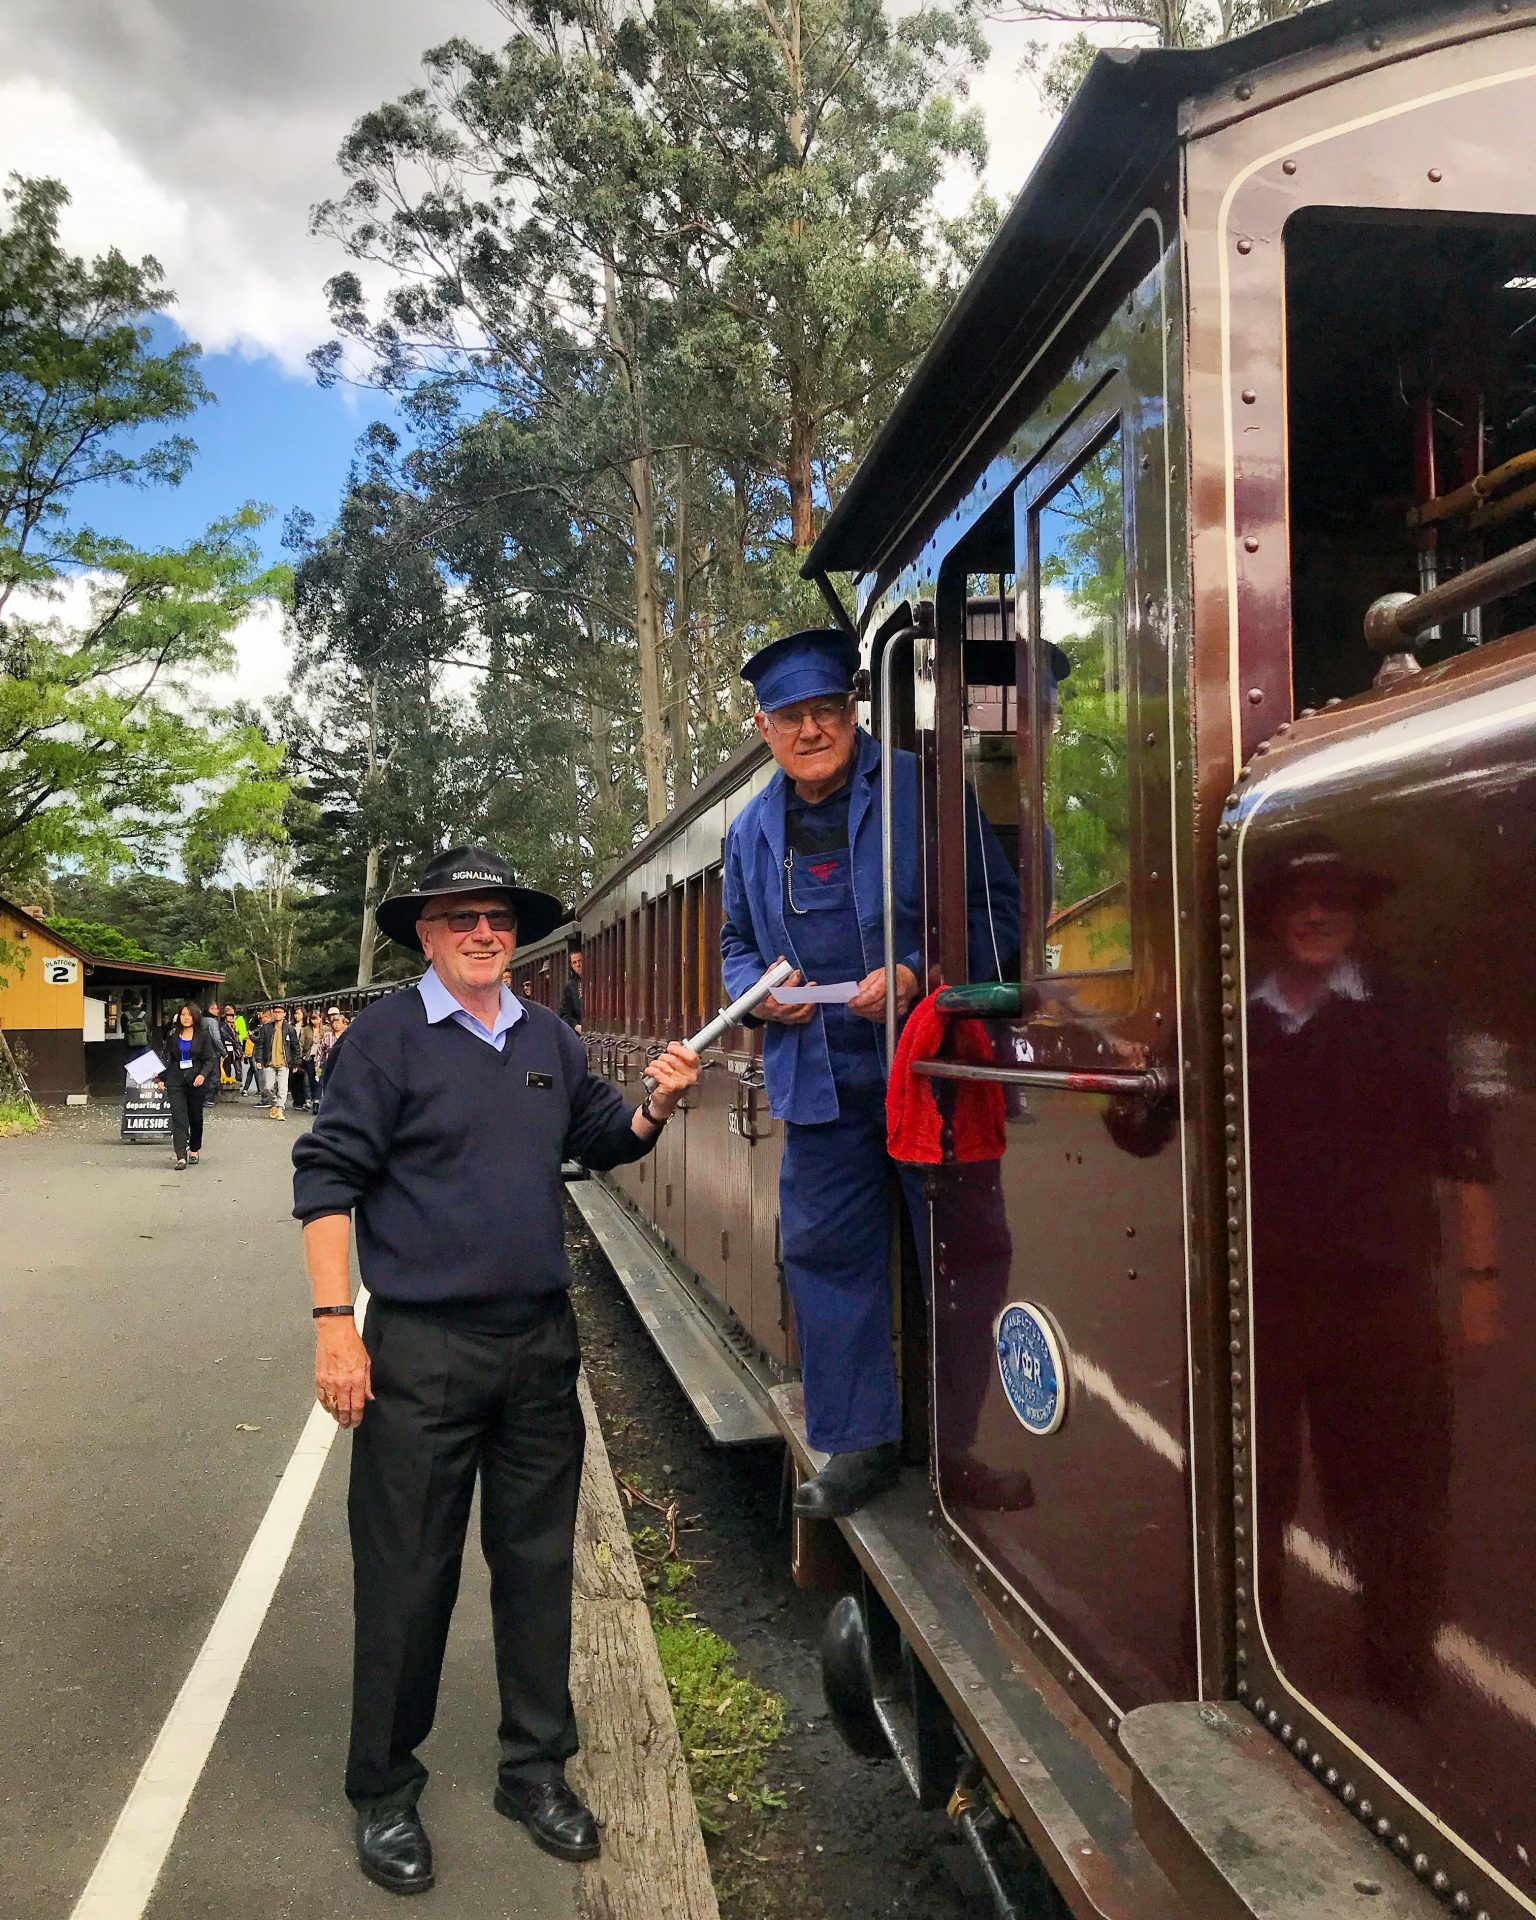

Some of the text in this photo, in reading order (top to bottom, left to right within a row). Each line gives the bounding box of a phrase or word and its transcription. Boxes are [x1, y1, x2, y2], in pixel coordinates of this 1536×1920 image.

[452, 871, 503, 884] SIGNALMAN
[45, 960, 77, 968] PLATFORM
[53, 967, 69, 982] 2
[126, 1102, 161, 1110] departing
[127, 1118, 169, 1128] LAKESIDE
